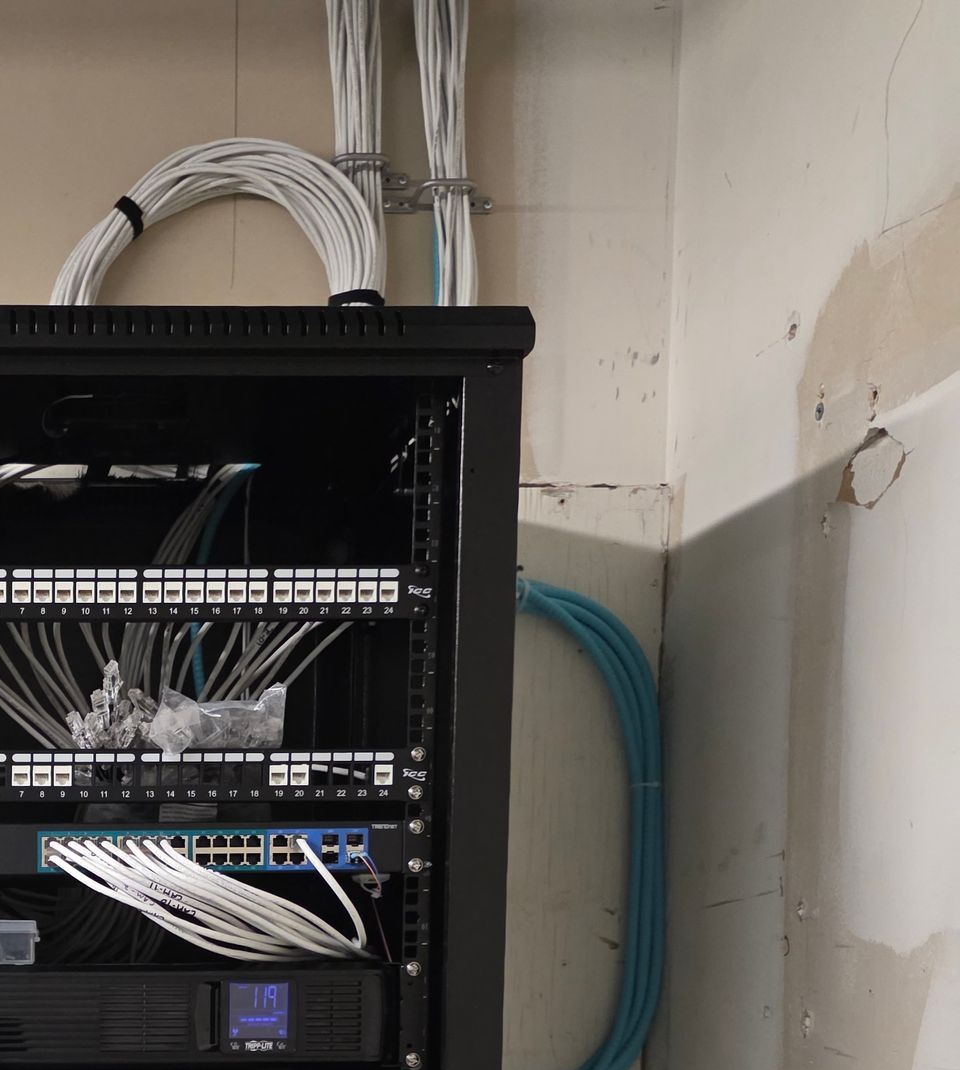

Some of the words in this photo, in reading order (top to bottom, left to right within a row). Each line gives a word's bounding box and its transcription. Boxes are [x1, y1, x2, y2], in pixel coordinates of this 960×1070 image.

[19, 607, 25, 615] 7
[40, 607, 46, 615] 8
[61, 607, 67, 615] 9
[81, 607, 91, 615] 10
[102, 607, 110, 615] 11
[123, 607, 133, 615] 12
[148, 607, 158, 615] 13
[169, 607, 178, 615] 14
[190, 607, 199, 615] 15
[211, 606, 221, 615] 16
[232, 606, 242, 615] 17
[254, 606, 263, 615] 18
[278, 606, 288, 615] 19
[298, 606, 309, 615] 20
[319, 606, 329, 615] 21
[341, 606, 352, 615] 22
[362, 606, 373, 615] 23
[383, 606, 394, 615] 24
[19, 790, 25, 798] 7
[39, 790, 45, 798] 8
[60, 790, 66, 798] 9
[79, 790, 89, 798] 10
[100, 790, 108, 798] 11
[121, 790, 131, 798] 12
[145, 790, 155, 798] 13
[166, 790, 175, 798] 14
[186, 790, 196, 798] 15
[208, 789, 217, 798] 16
[228, 789, 238, 798] 17
[250, 789, 260, 798] 18
[274, 789, 284, 798] 19
[294, 789, 305, 798] 20
[315, 789, 325, 798] 21
[336, 789, 347, 798] 22
[357, 789, 368, 798] 23
[378, 789, 389, 798] 24
[253, 985, 278, 1009] 119
